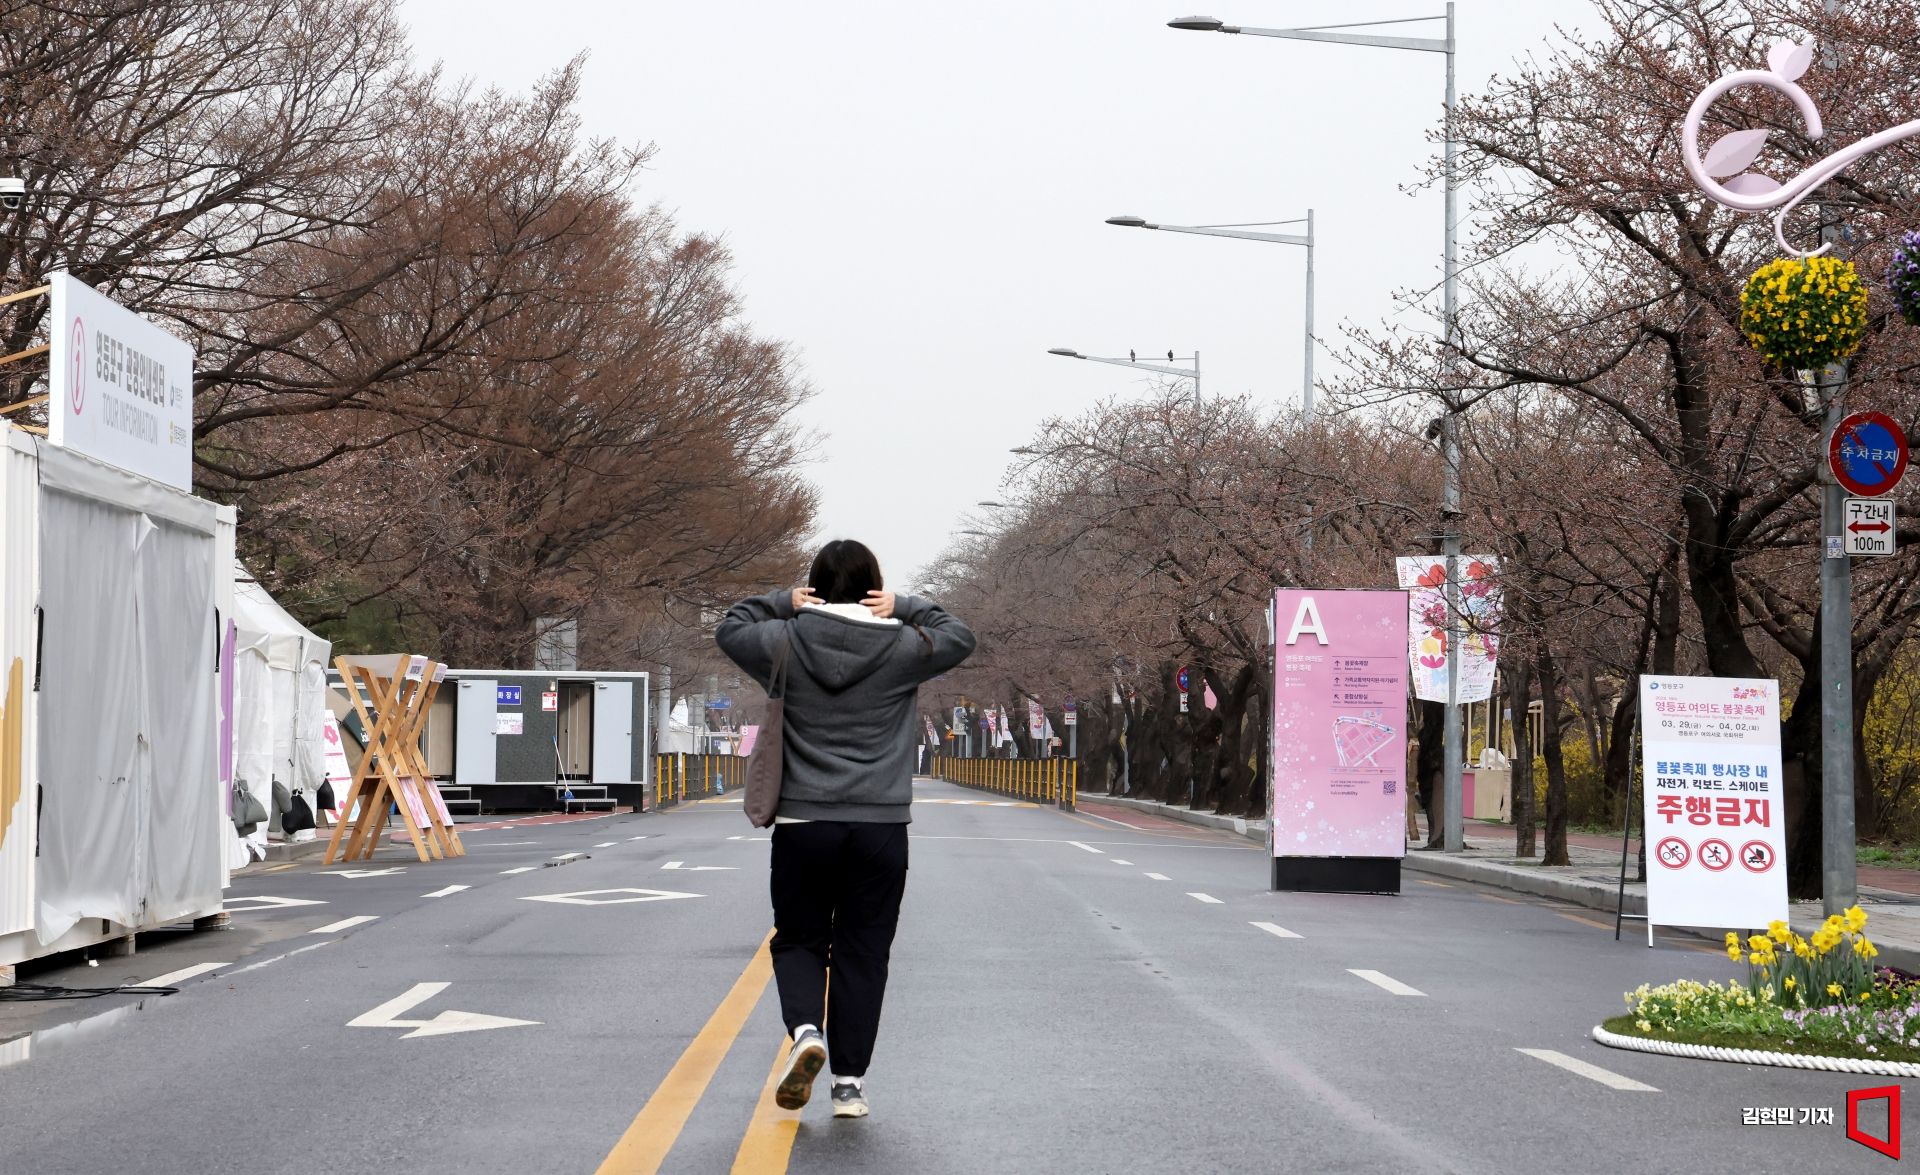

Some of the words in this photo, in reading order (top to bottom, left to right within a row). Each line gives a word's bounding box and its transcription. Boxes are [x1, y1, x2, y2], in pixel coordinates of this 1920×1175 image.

[96, 329, 123, 387] 영등포구
[126, 346, 165, 408] 관광안내센터
[102, 392, 118, 431] TOUR
[119, 402, 158, 445] INFORMATION
[1842, 447, 1896, 462] 주차금지
[1850, 504, 1888, 520] 구간내
[1853, 536, 1885, 552] 100m
[1285, 597, 1329, 646] A
[1655, 701, 1687, 712] 영등포
[1689, 702, 1721, 714] 여의도
[1723, 704, 1765, 716] 봄꽃축제
[1656, 761, 1706, 776] 봄꽃축제
[1712, 763, 1751, 778] 행사장
[1756, 765, 1768, 778] 내
[1728, 781, 1769, 792] 스케이트
[1656, 794, 1770, 828] 주행금지
